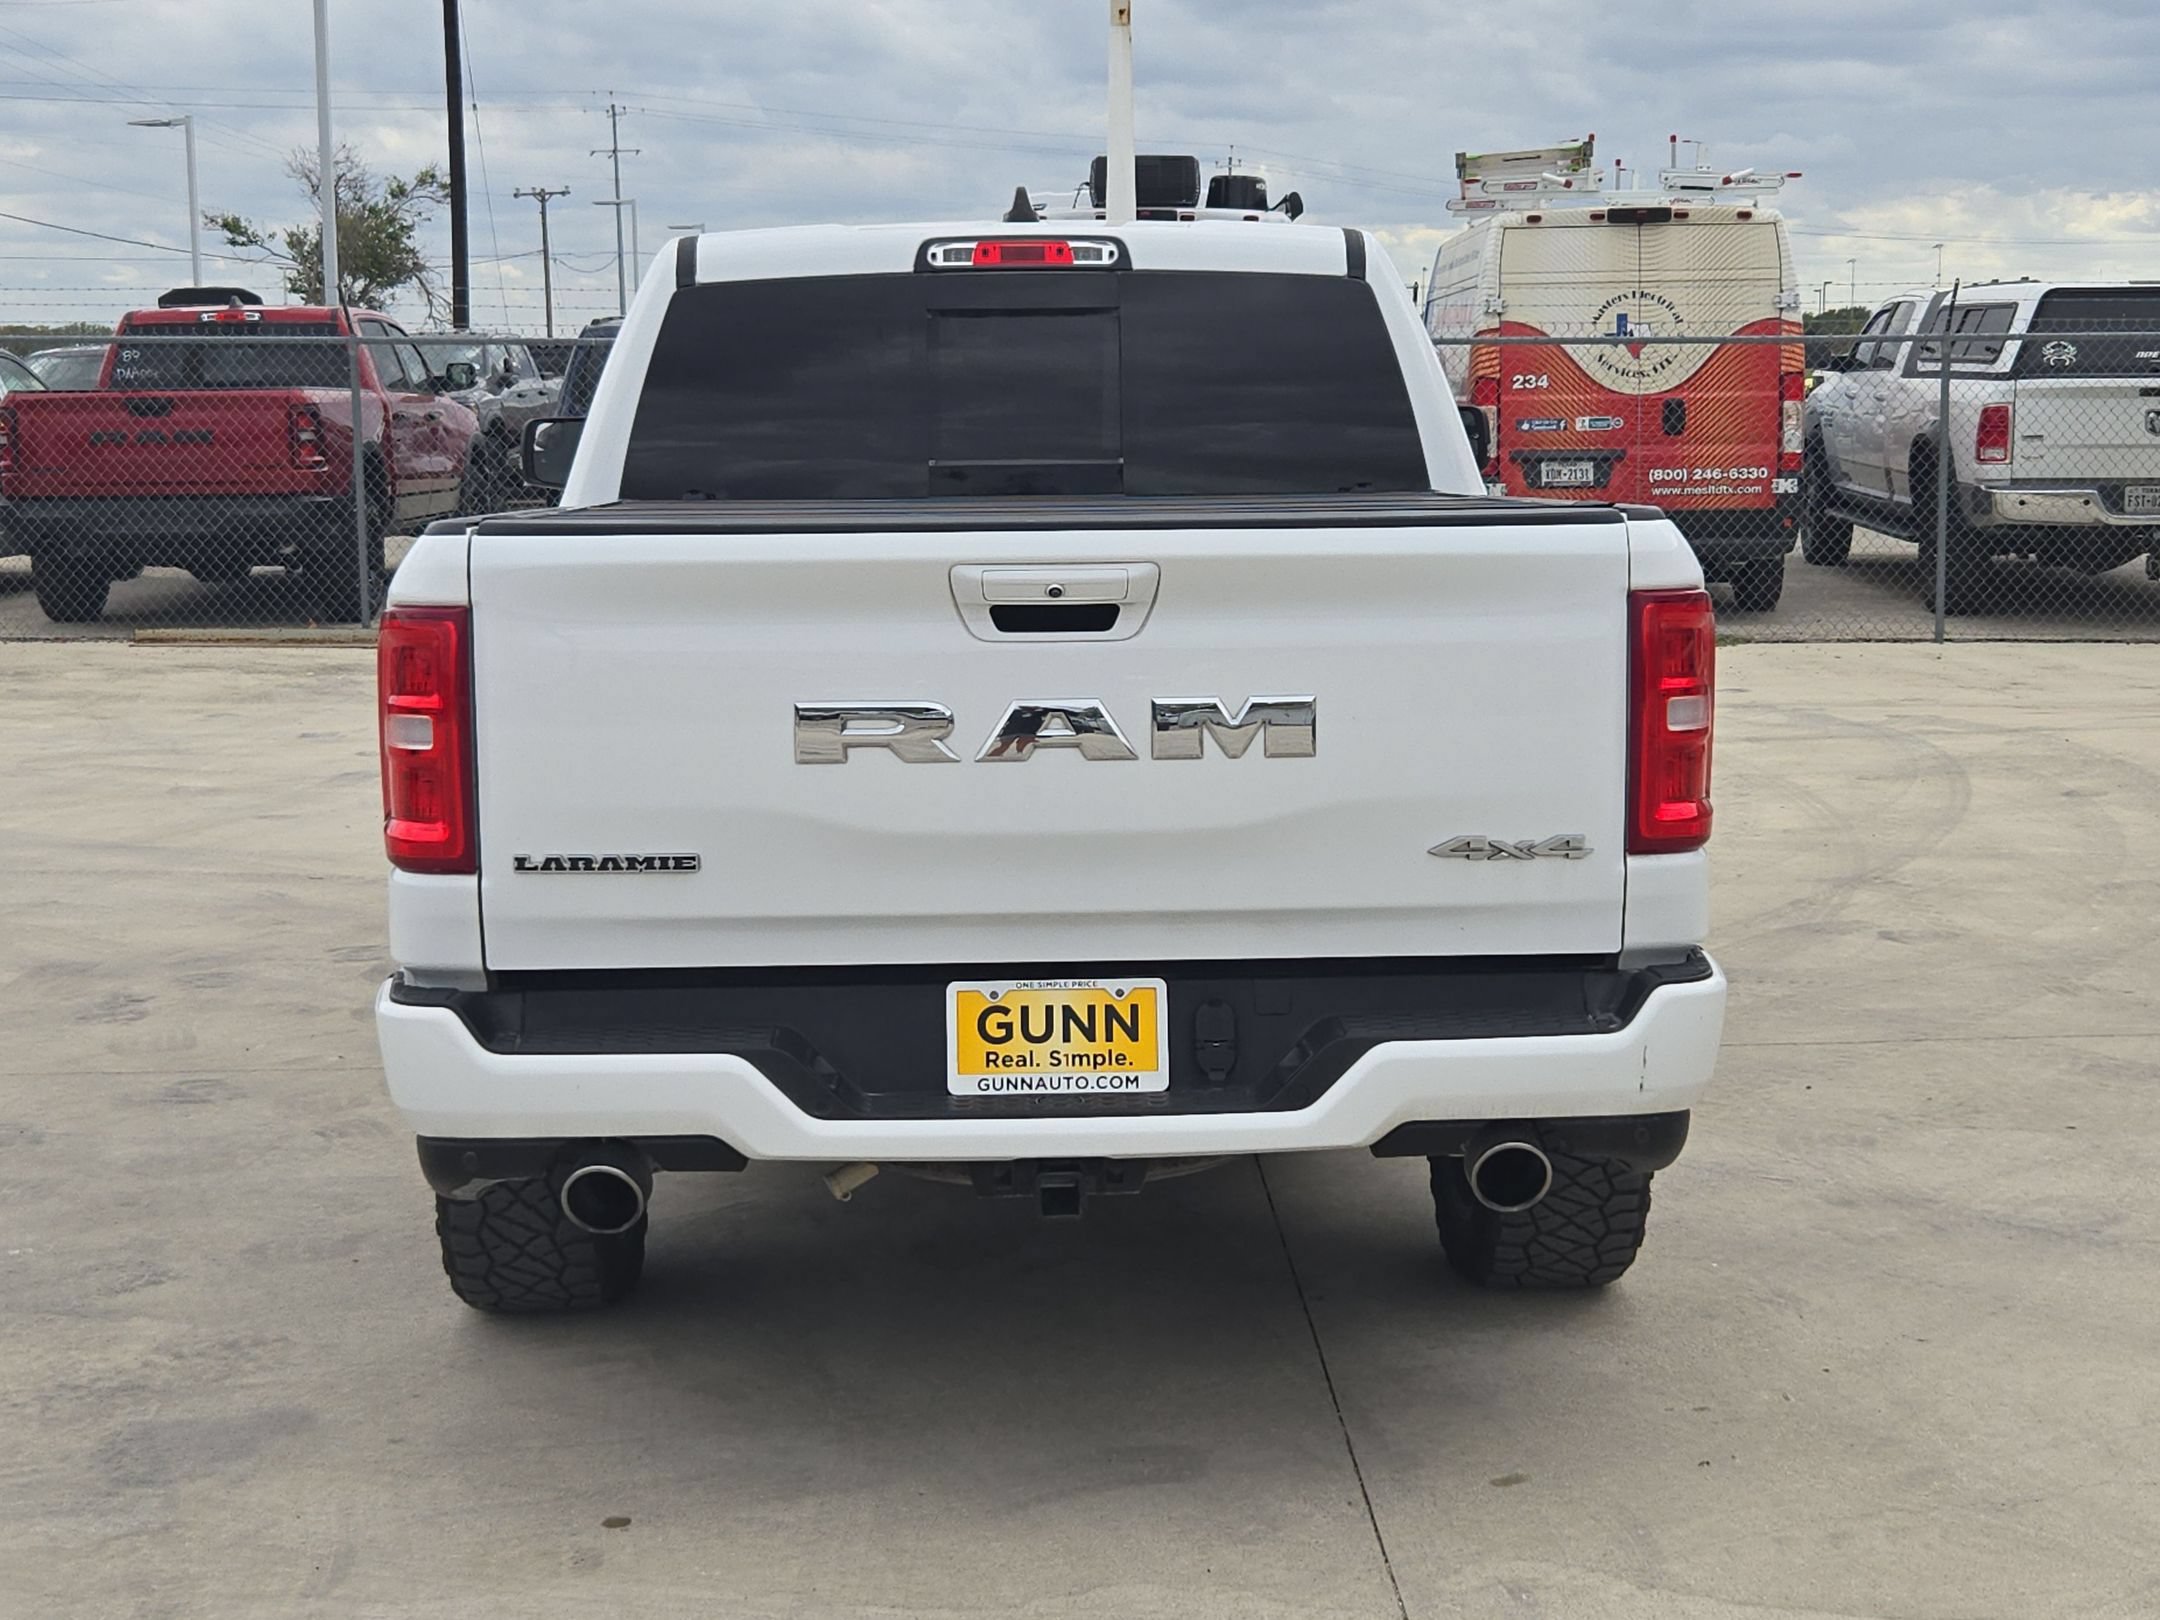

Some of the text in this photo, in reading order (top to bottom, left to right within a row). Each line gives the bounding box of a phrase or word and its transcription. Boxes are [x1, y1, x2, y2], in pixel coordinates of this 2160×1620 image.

[1512, 374, 1549, 390] 234
[1648, 467, 1769, 483] (800) 246-6330
[794, 695, 1318, 764] RAM
[1426, 833, 1595, 860] 4x4
[513, 853, 701, 873] LARAMIE
[1037, 981, 1070, 989] SIMPLE
[1071, 980, 1099, 988] PRICE
[976, 1004, 1140, 1045] GUNN
[985, 1051, 1041, 1069] Real.
[977, 1076, 1140, 1092] GUNNAUTO.COM
